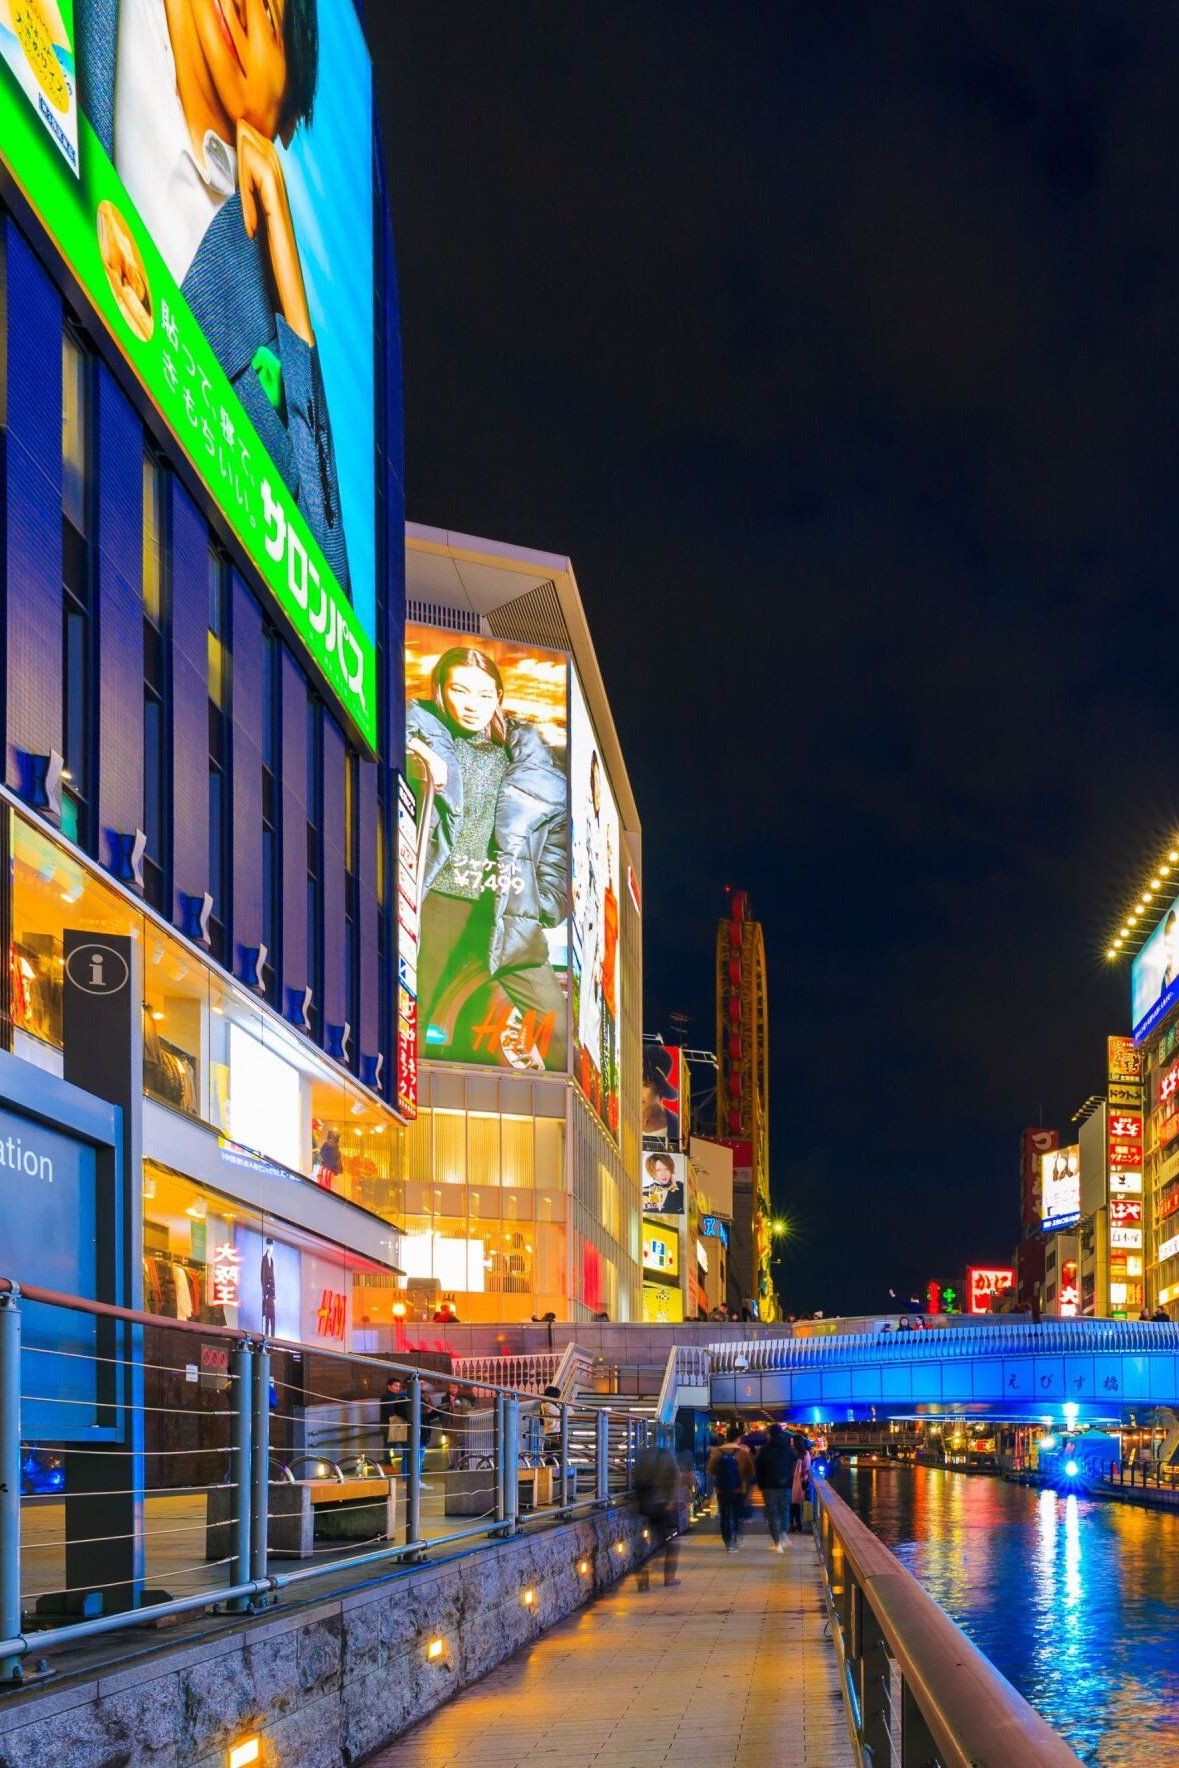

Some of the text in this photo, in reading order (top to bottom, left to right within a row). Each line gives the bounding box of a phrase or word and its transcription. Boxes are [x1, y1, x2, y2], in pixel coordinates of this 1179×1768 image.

[260, 476, 367, 712] サロンパス
[453, 869, 526, 895] ¥7,499
[975, 1273, 1009, 1291] かに
[1007, 1374, 1120, 1393] えびす橋
